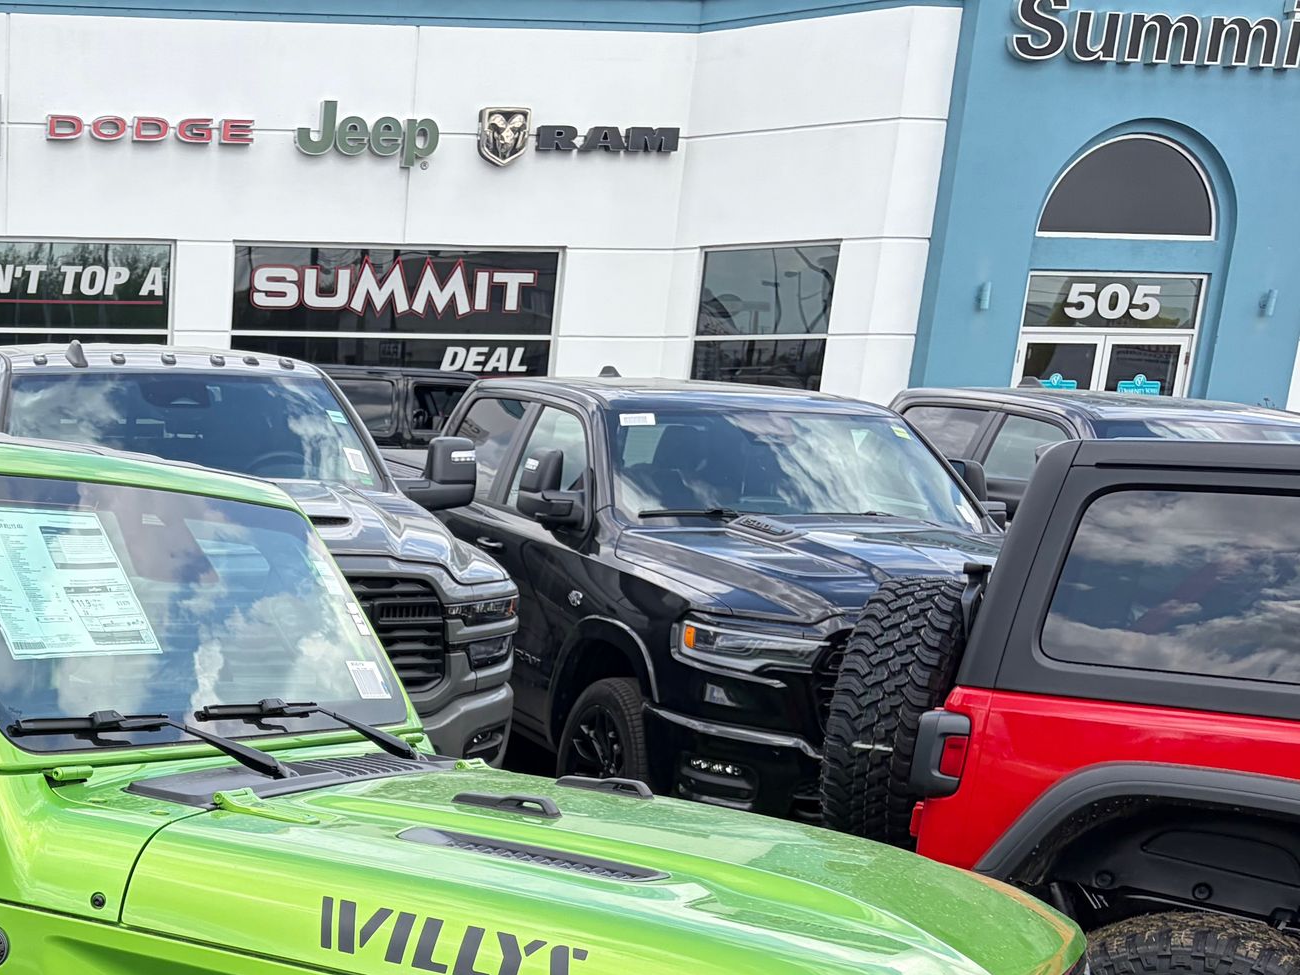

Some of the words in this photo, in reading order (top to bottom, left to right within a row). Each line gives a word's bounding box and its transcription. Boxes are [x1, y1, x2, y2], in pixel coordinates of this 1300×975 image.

[46, 114, 255, 145] DODGE
[297, 100, 439, 168] Jeep
[536, 125, 681, 153] RAM
[60, 265, 131, 296] TOP
[141, 266, 164, 296] A
[251, 256, 538, 320] SUMMIT
[1064, 283, 1162, 321] 505
[440, 346, 528, 373] DEAL
